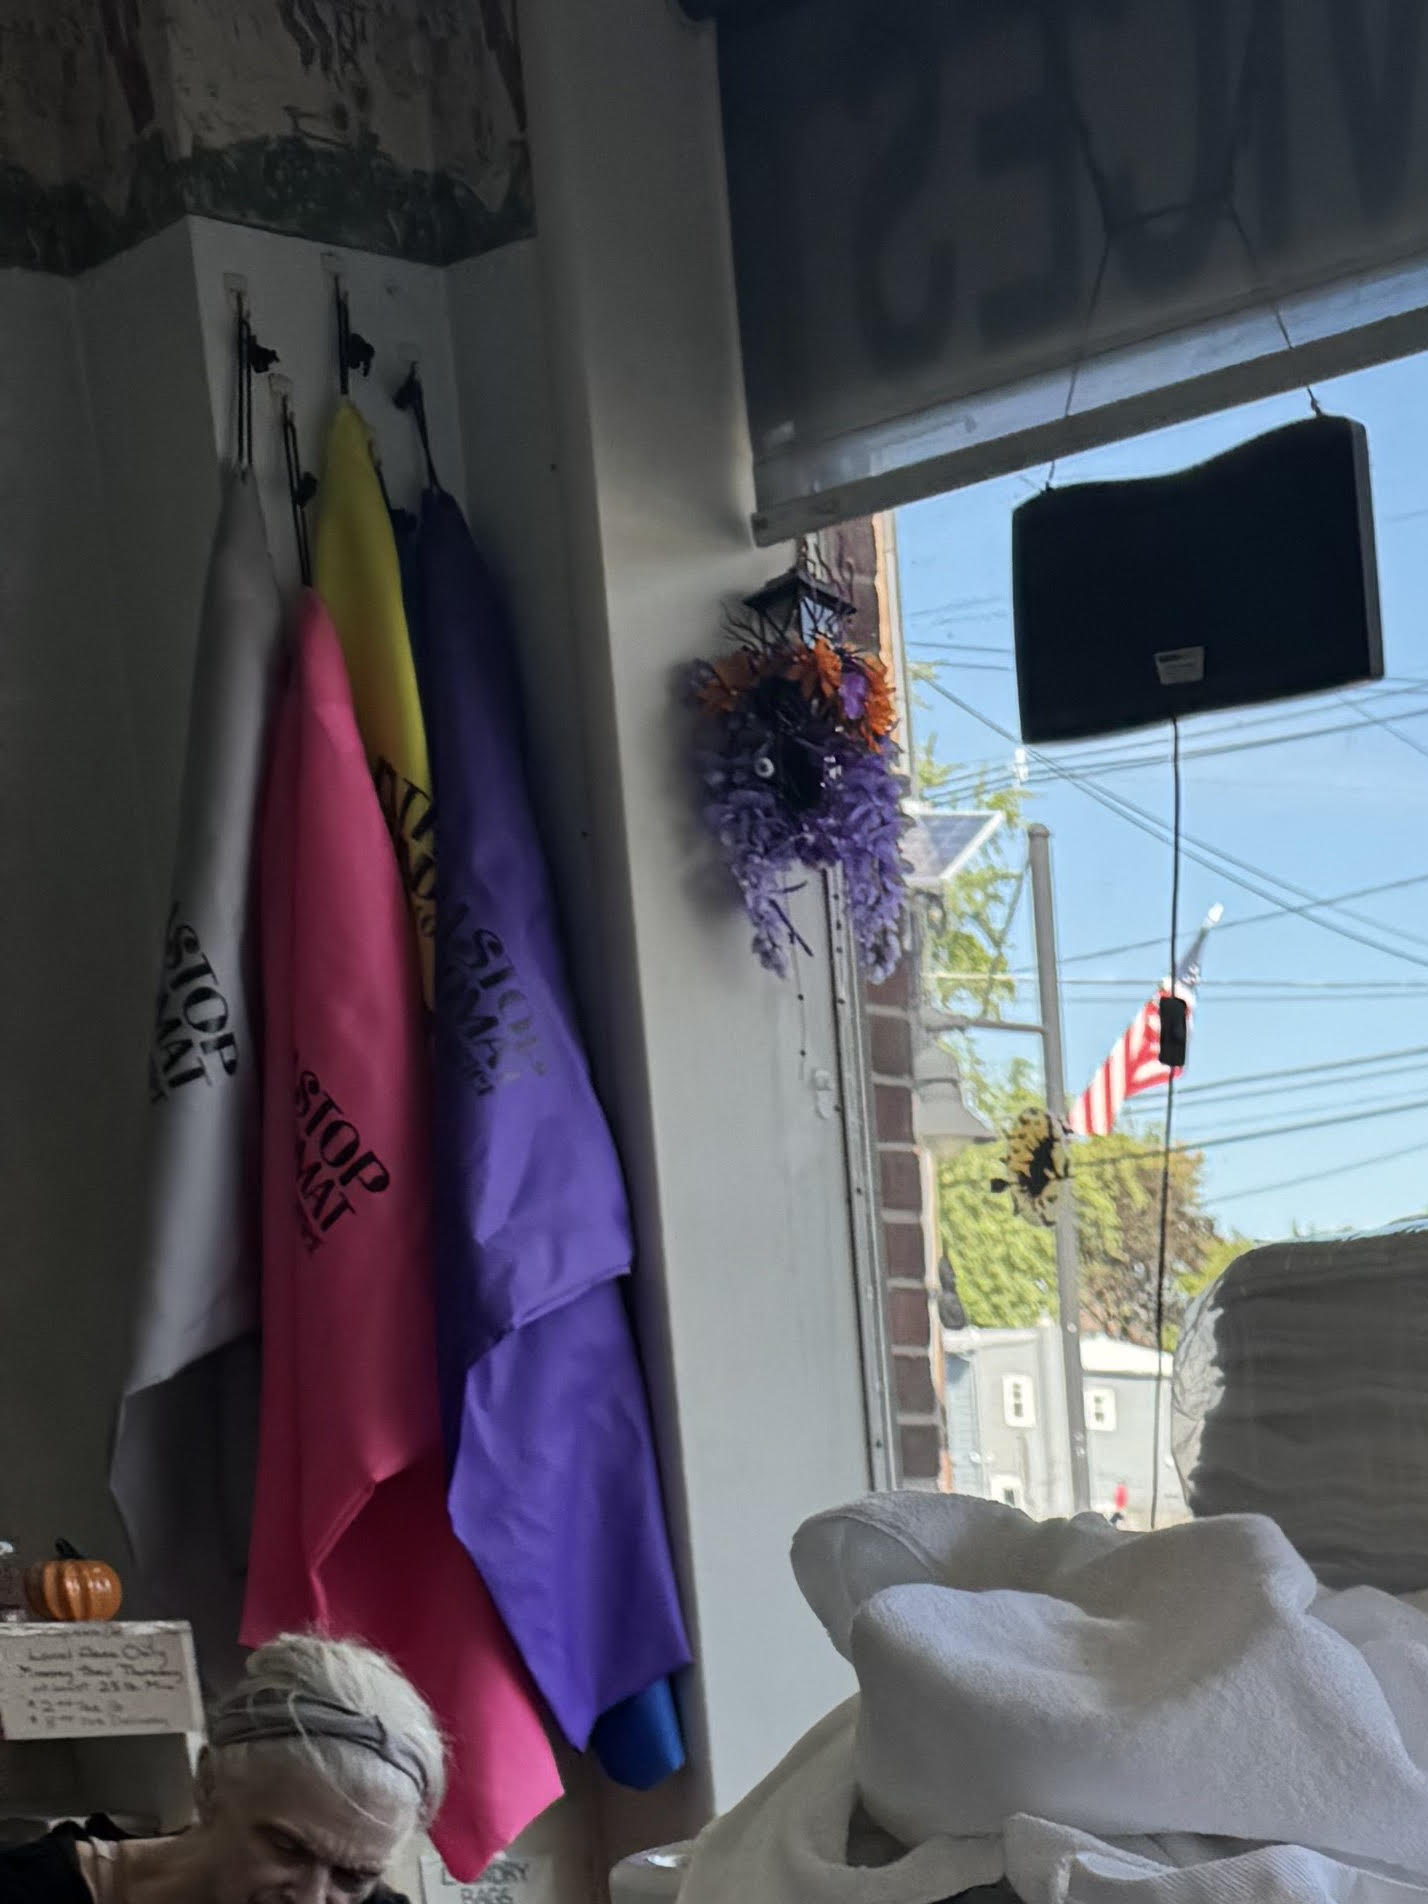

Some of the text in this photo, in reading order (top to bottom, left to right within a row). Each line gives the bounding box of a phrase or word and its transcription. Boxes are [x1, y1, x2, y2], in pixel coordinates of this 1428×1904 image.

[165, 924, 239, 1077] STOP
[294, 1070, 391, 1193] STOP
[441, 1861, 530, 1886] LDRY
